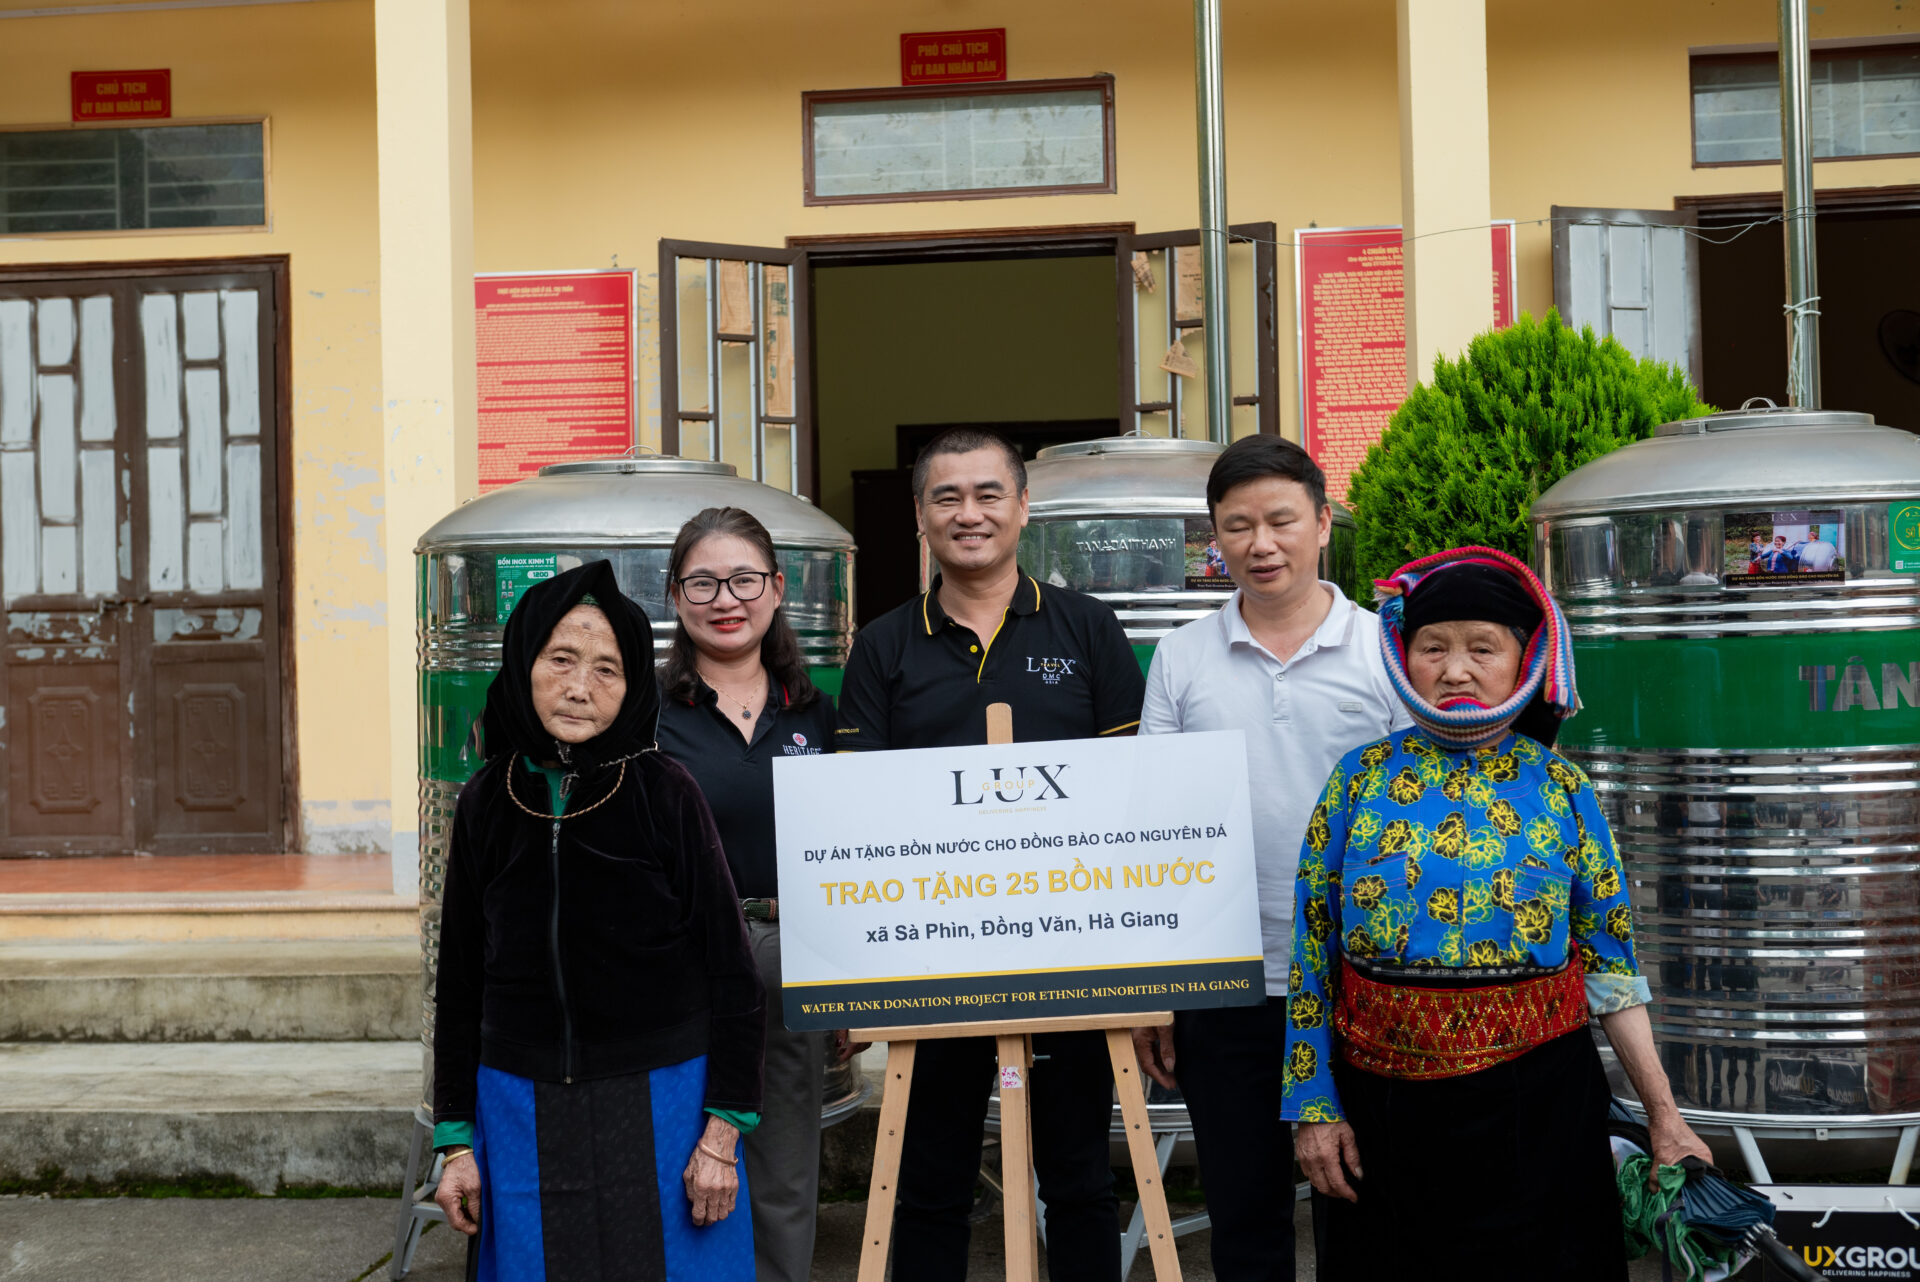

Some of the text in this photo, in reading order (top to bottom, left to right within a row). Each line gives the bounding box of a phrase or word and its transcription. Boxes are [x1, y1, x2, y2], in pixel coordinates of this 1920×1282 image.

[918, 40, 989, 56] PHÓ CHỦ TỊCH
[926, 63, 945, 75] BAN
[947, 60, 974, 74] NHÂN
[977, 59, 996, 72] DÂN
[96, 79, 147, 96] CHỦ TỊCH
[95, 101, 114, 113] BAN
[1771, 512, 1798, 522] LUX
[545, 556, 555, 564] TẾ
[1026, 656, 1075, 674] LUX
[949, 764, 1070, 805] LUX
[982, 779, 1035, 791] GROUP
[804, 823, 1227, 864] DỰ ÁN TẶNG BỒN NƯỚC CHO ĐỒNG BÀO CAO NGUYÊN ĐÁ
[819, 857, 1215, 905] TRAO TẶNG 25 BỒN NƯỚC
[866, 911, 1179, 943] xã Sà Phìn, Đồng Văn, Hà Giang
[802, 979, 1250, 1014] WATER TANK DONATION PROJECT FOR ETHNIC MINORITIES IN HA GIANG
[1787, 1246, 1920, 1270] UXGROU
[1822, 1269, 1911, 1278] DELIVERING HAPPINESS
